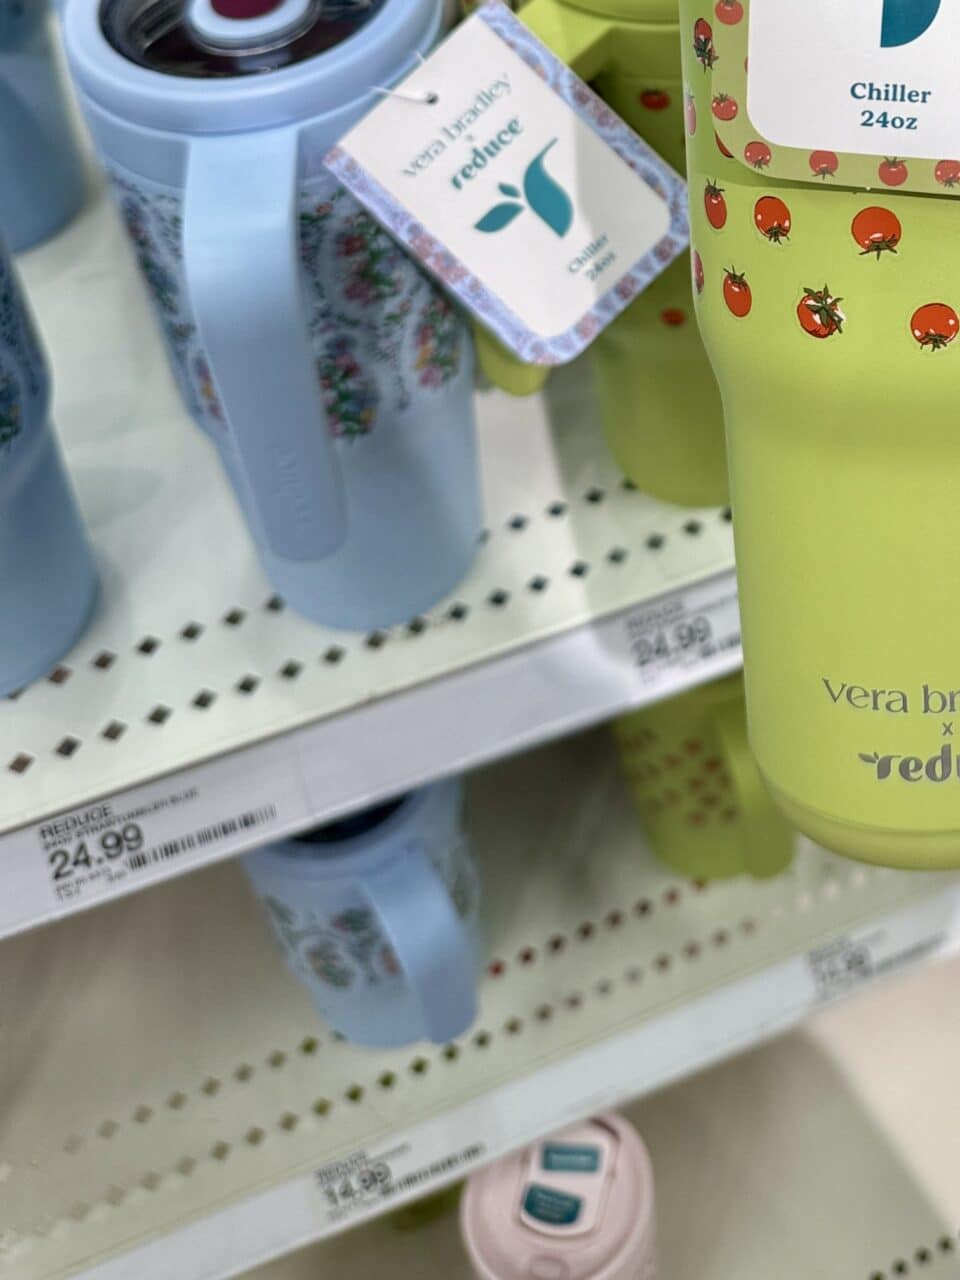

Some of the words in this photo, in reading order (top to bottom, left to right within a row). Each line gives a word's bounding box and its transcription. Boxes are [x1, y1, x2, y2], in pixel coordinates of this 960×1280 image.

[850, 82, 932, 104] Chiller
[402, 138, 448, 176] vera
[441, 72, 511, 141] bradley
[860, 110, 918, 130] 24oz
[450, 116, 524, 191] reduce
[631, 615, 713, 667] 24.99
[821, 677, 910, 714] vera
[941, 721, 955, 737] x
[40, 803, 113, 840] REDUCE
[48, 821, 144, 881] 24.99
[323, 1160, 393, 1208] 14.99
